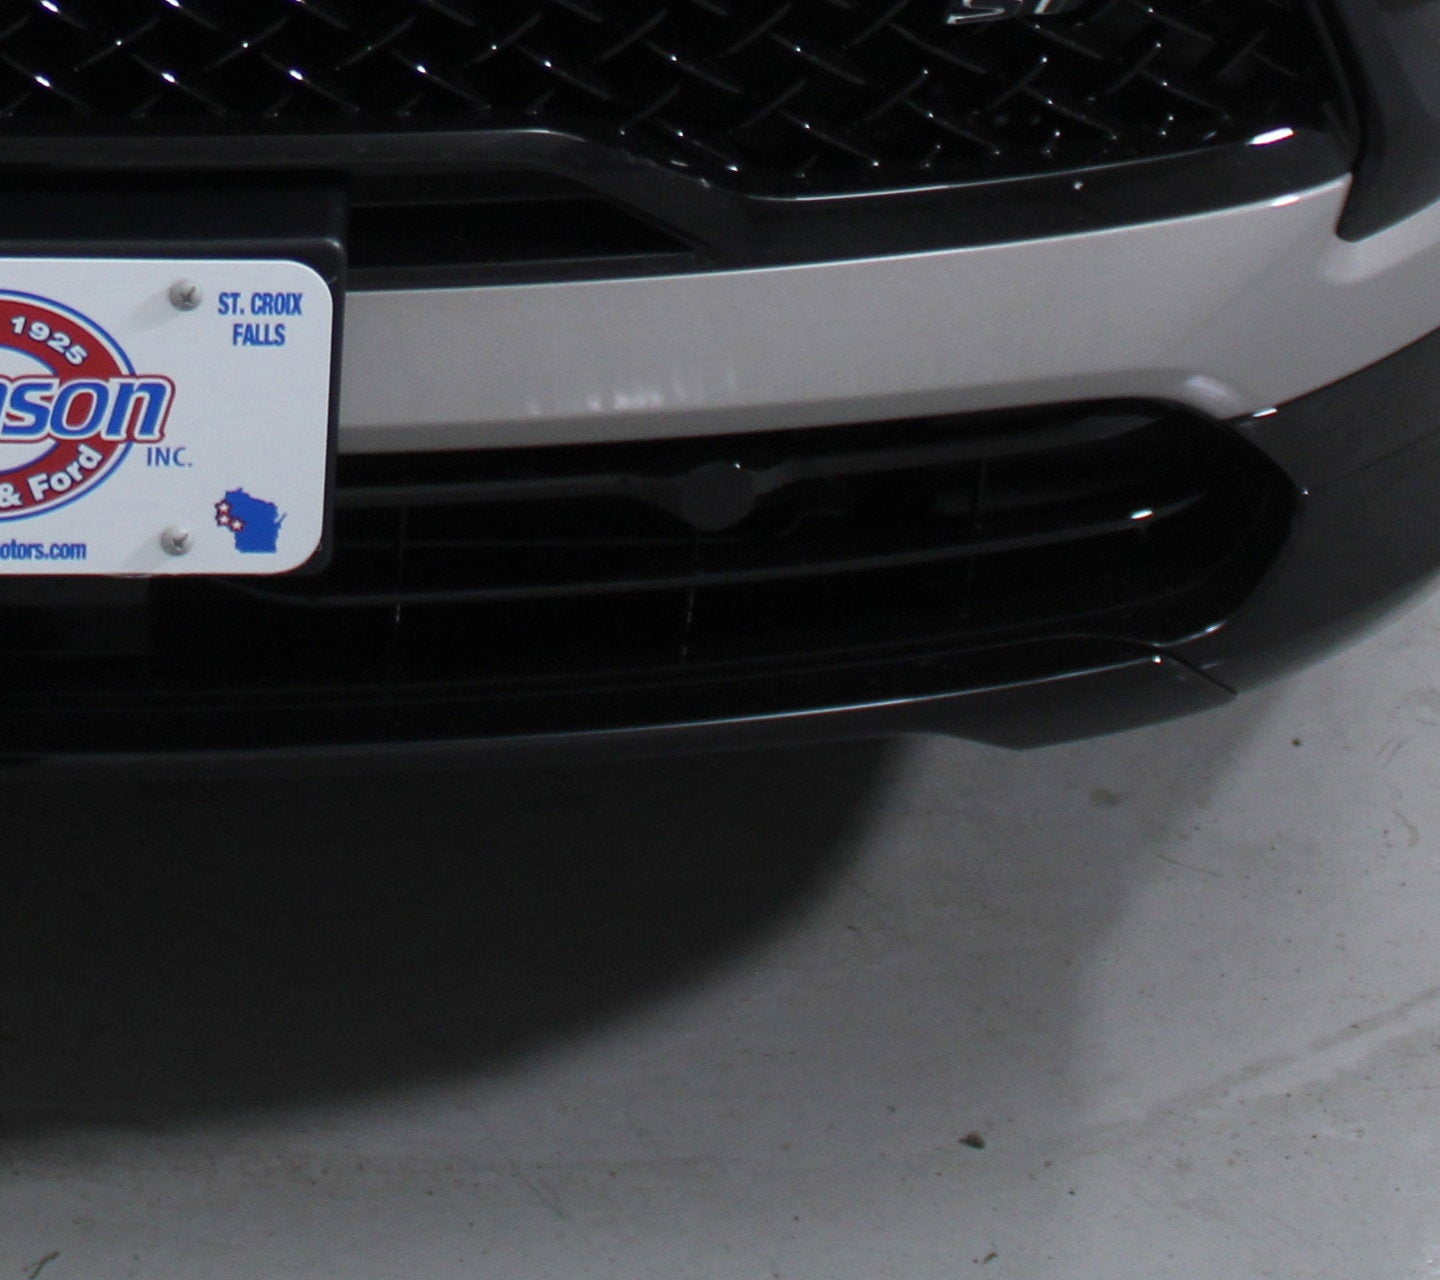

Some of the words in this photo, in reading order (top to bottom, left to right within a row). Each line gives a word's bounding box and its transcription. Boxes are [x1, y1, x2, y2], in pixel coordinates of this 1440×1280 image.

[218, 292, 245, 315] ST.
[251, 292, 302, 315] CROIX
[11, 316, 88, 365] 1925
[232, 323, 286, 346] FALLS
[146, 445, 194, 468] INC.
[27, 443, 103, 500] Ford
